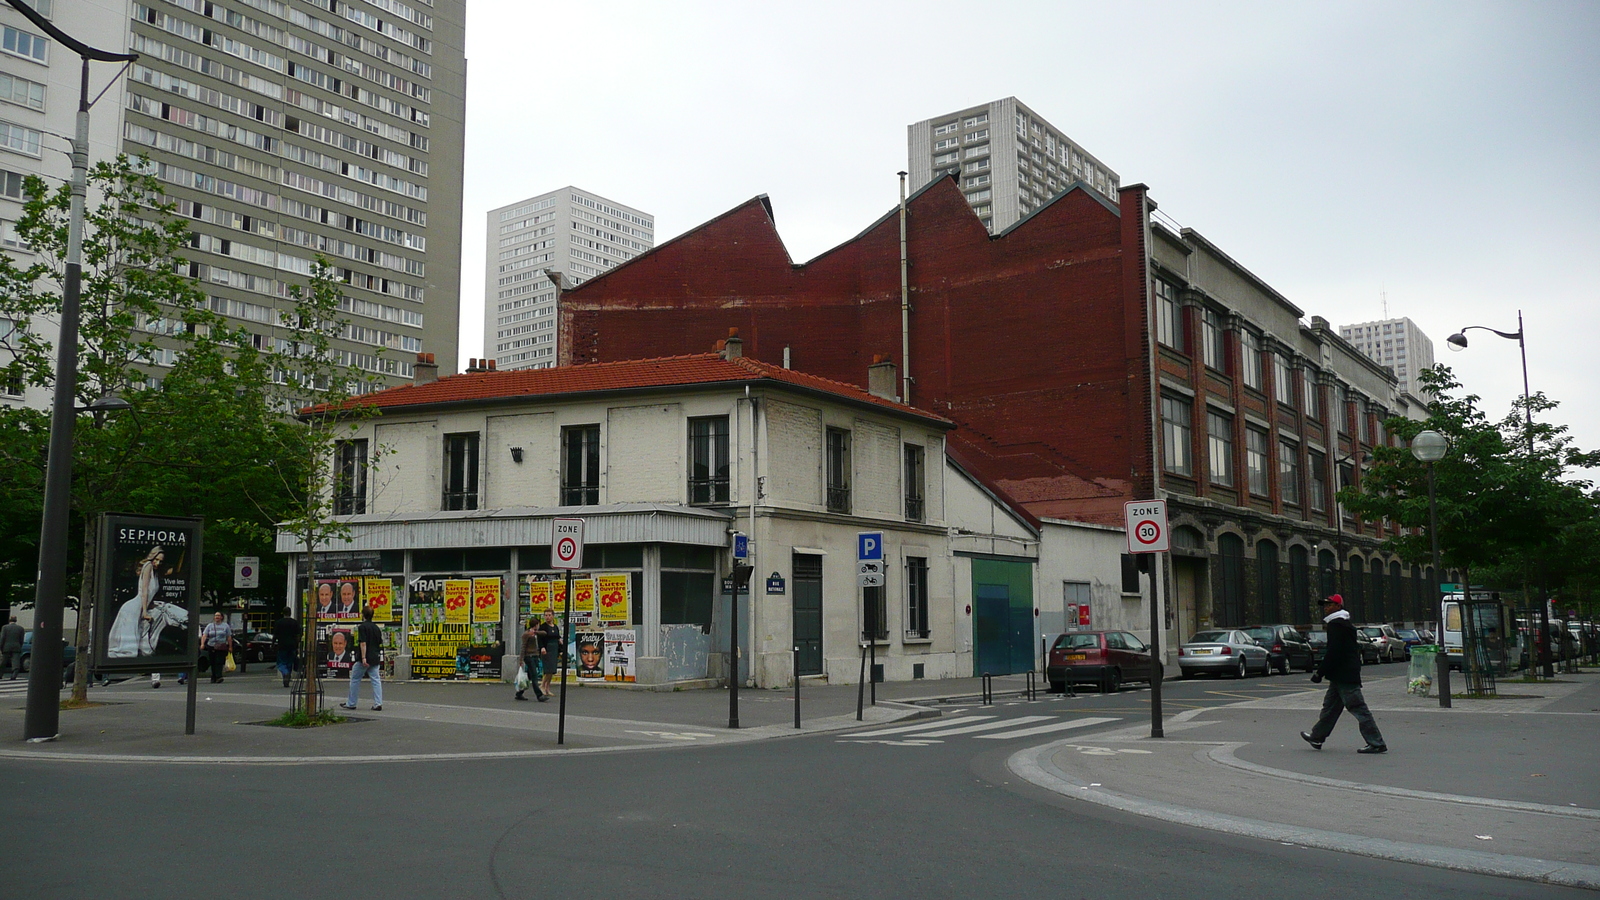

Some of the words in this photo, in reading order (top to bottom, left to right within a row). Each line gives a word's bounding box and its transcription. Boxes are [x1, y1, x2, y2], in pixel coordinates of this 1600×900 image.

[1132, 507, 1159, 516] ZONE
[120, 528, 186, 542] SEPHORA
[1141, 528, 1154, 536] 30
[562, 545, 572, 554] 30
[864, 538, 876, 556] P
